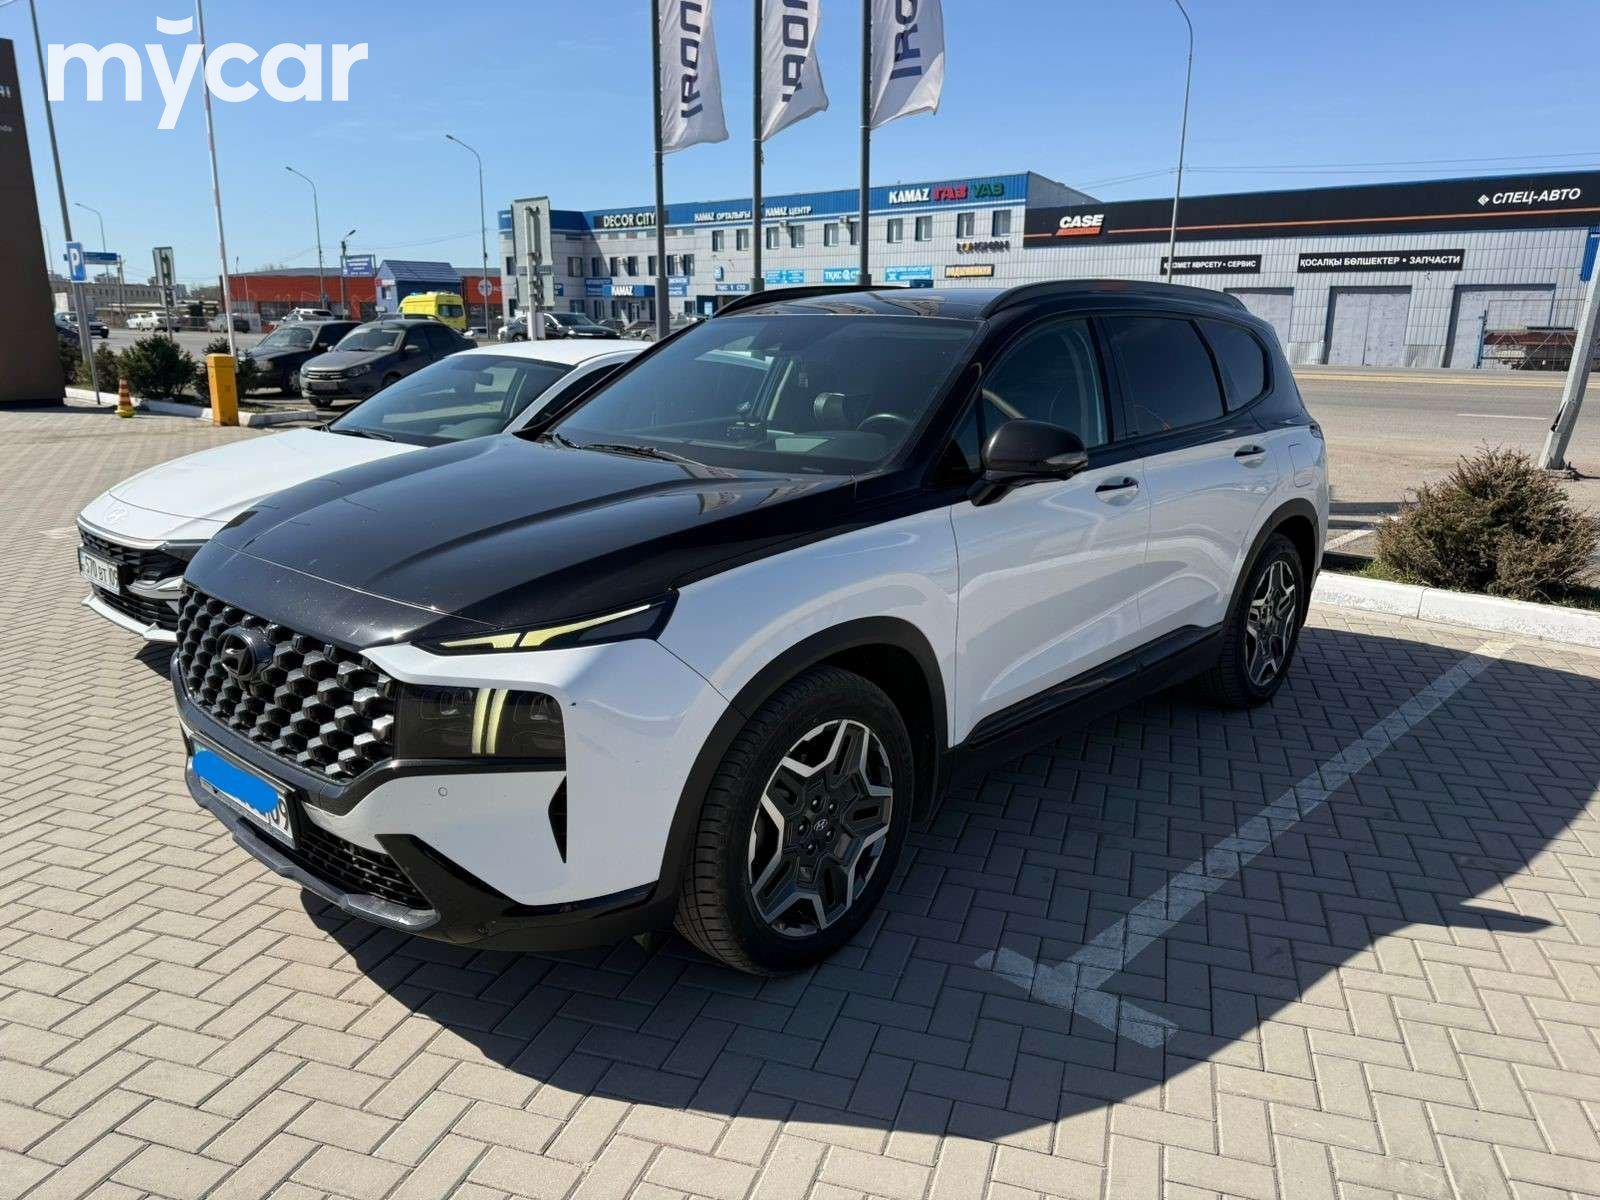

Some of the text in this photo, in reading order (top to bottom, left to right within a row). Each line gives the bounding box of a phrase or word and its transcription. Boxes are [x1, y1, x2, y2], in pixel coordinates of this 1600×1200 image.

[889, 188, 930, 205] KAMAZ
[932, 184, 968, 201] ГАЗ
[972, 181, 1004, 197] УАЗ
[1491, 187, 1582, 206] СПЕЦ-АВТО
[694, 212, 715, 222] KAMAZ
[765, 205, 812, 217] KAMAZ ЦЕНТР
[603, 212, 656, 228] DECOR CITY
[1059, 214, 1104, 228] CASE
[69, 247, 80, 269] P
[1227, 260, 1257, 269] СЕРВИС
[1299, 255, 1461, 268] ҚОСАЛҚЫ БӨЛШЕКТЕР ЗАПЧАСТИ
[611, 285, 633, 297] KAMAZ
